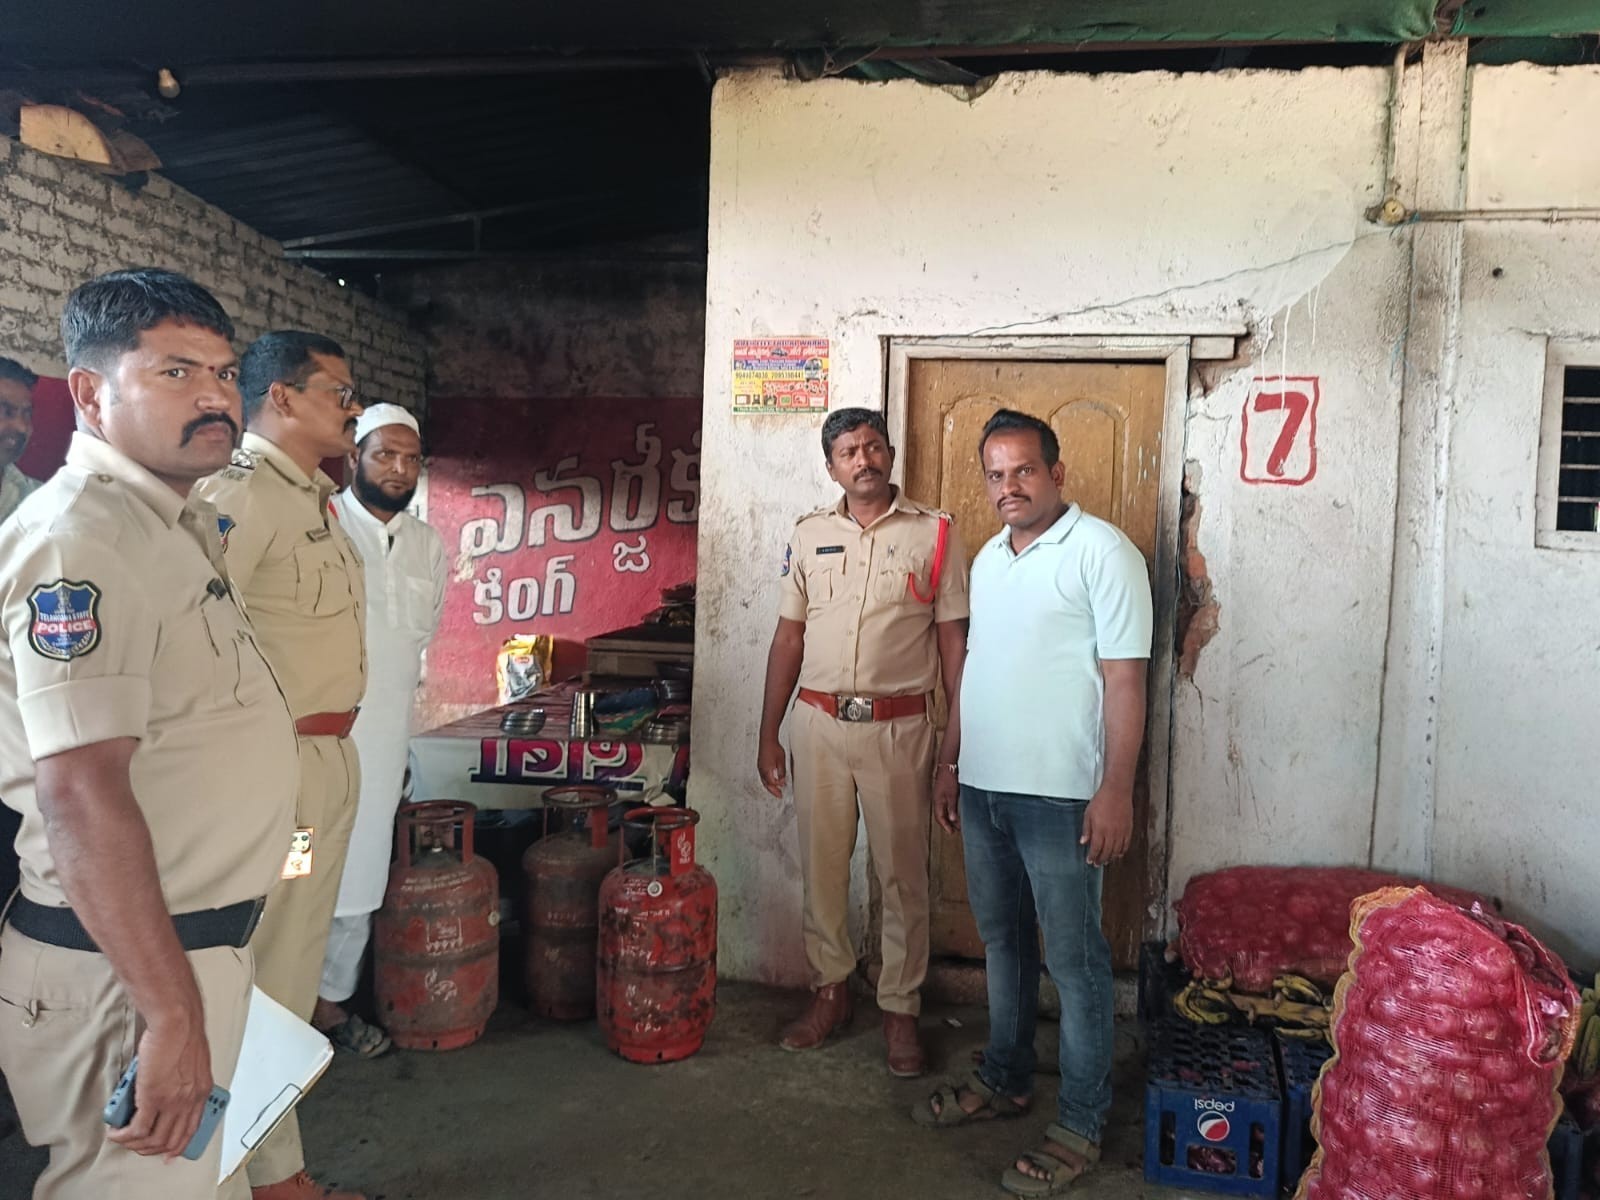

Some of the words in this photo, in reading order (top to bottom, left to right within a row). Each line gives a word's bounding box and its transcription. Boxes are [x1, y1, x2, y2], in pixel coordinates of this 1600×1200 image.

[1254, 391, 1309, 477] 7
[37, 621, 93, 634] POLICE
[1193, 1098, 1235, 1112] pepsi
